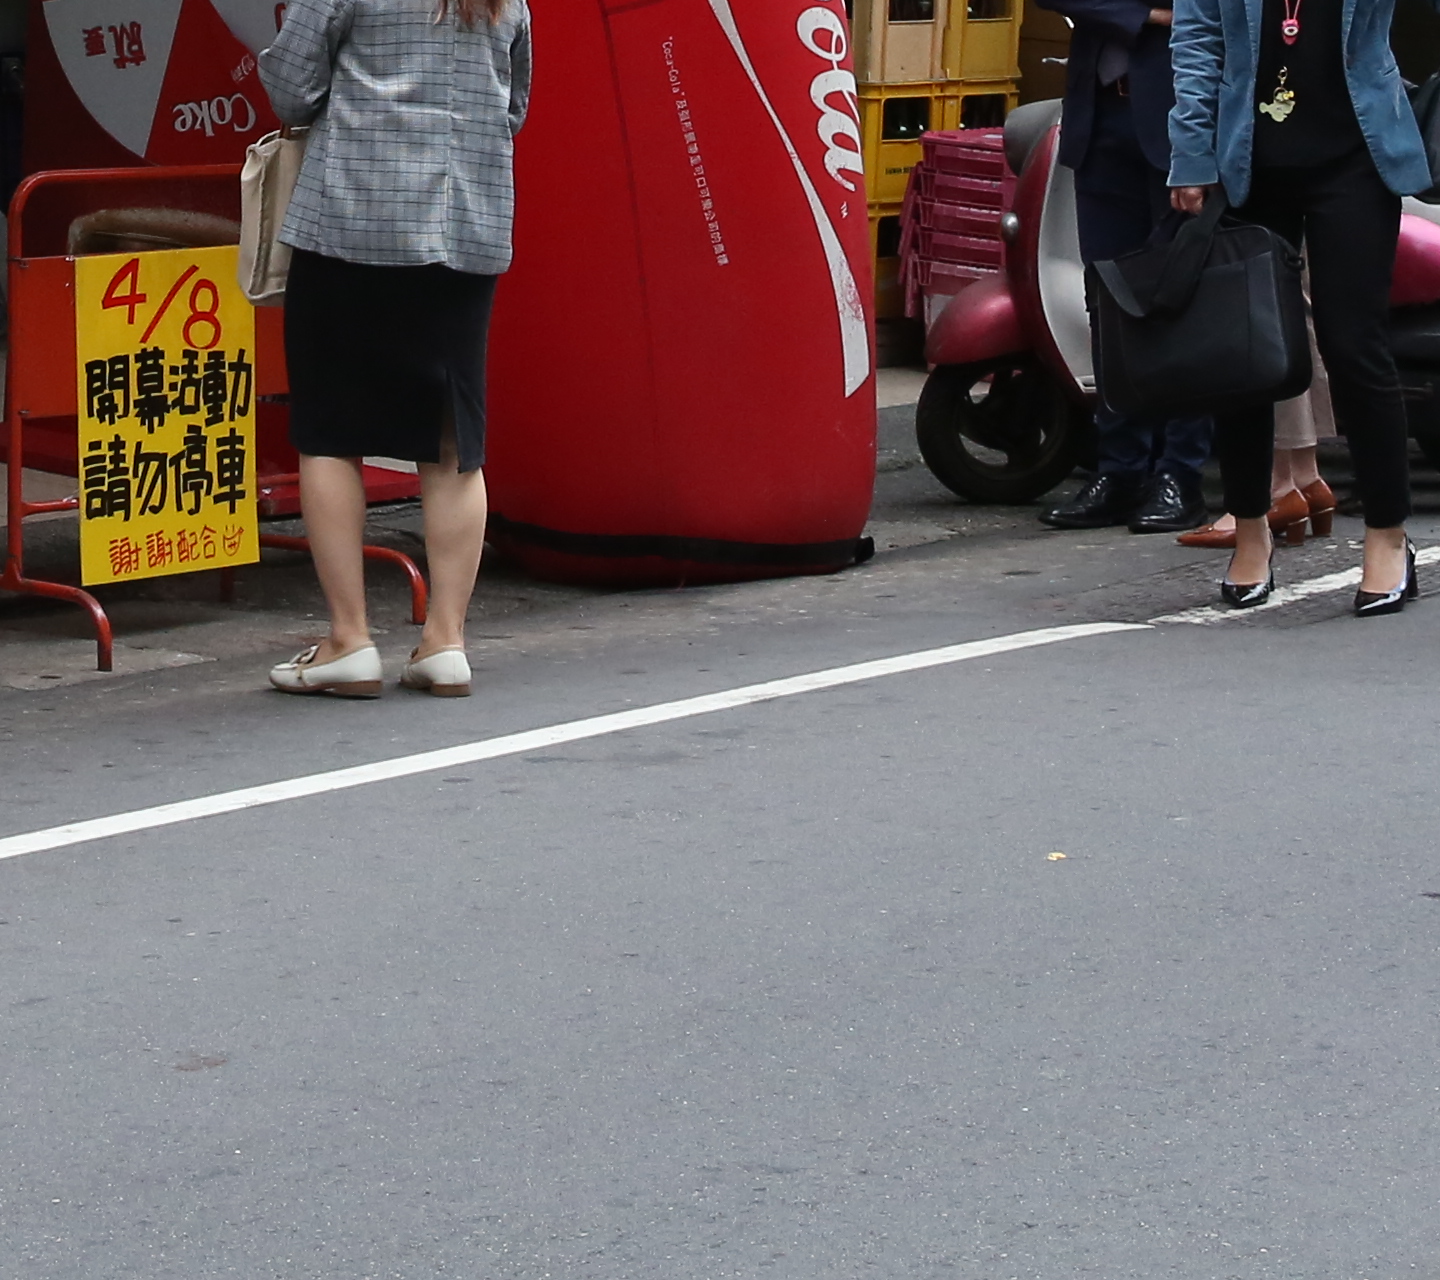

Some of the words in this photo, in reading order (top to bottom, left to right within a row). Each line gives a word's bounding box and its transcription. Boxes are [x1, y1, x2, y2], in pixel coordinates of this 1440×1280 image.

[173, 92, 257, 138] Coke
[100, 257, 222, 350] 4/8
[84, 345, 252, 434] 開幕活動
[82, 424, 247, 522] 請勿停車
[108, 524, 217, 576] 謝謝配合
